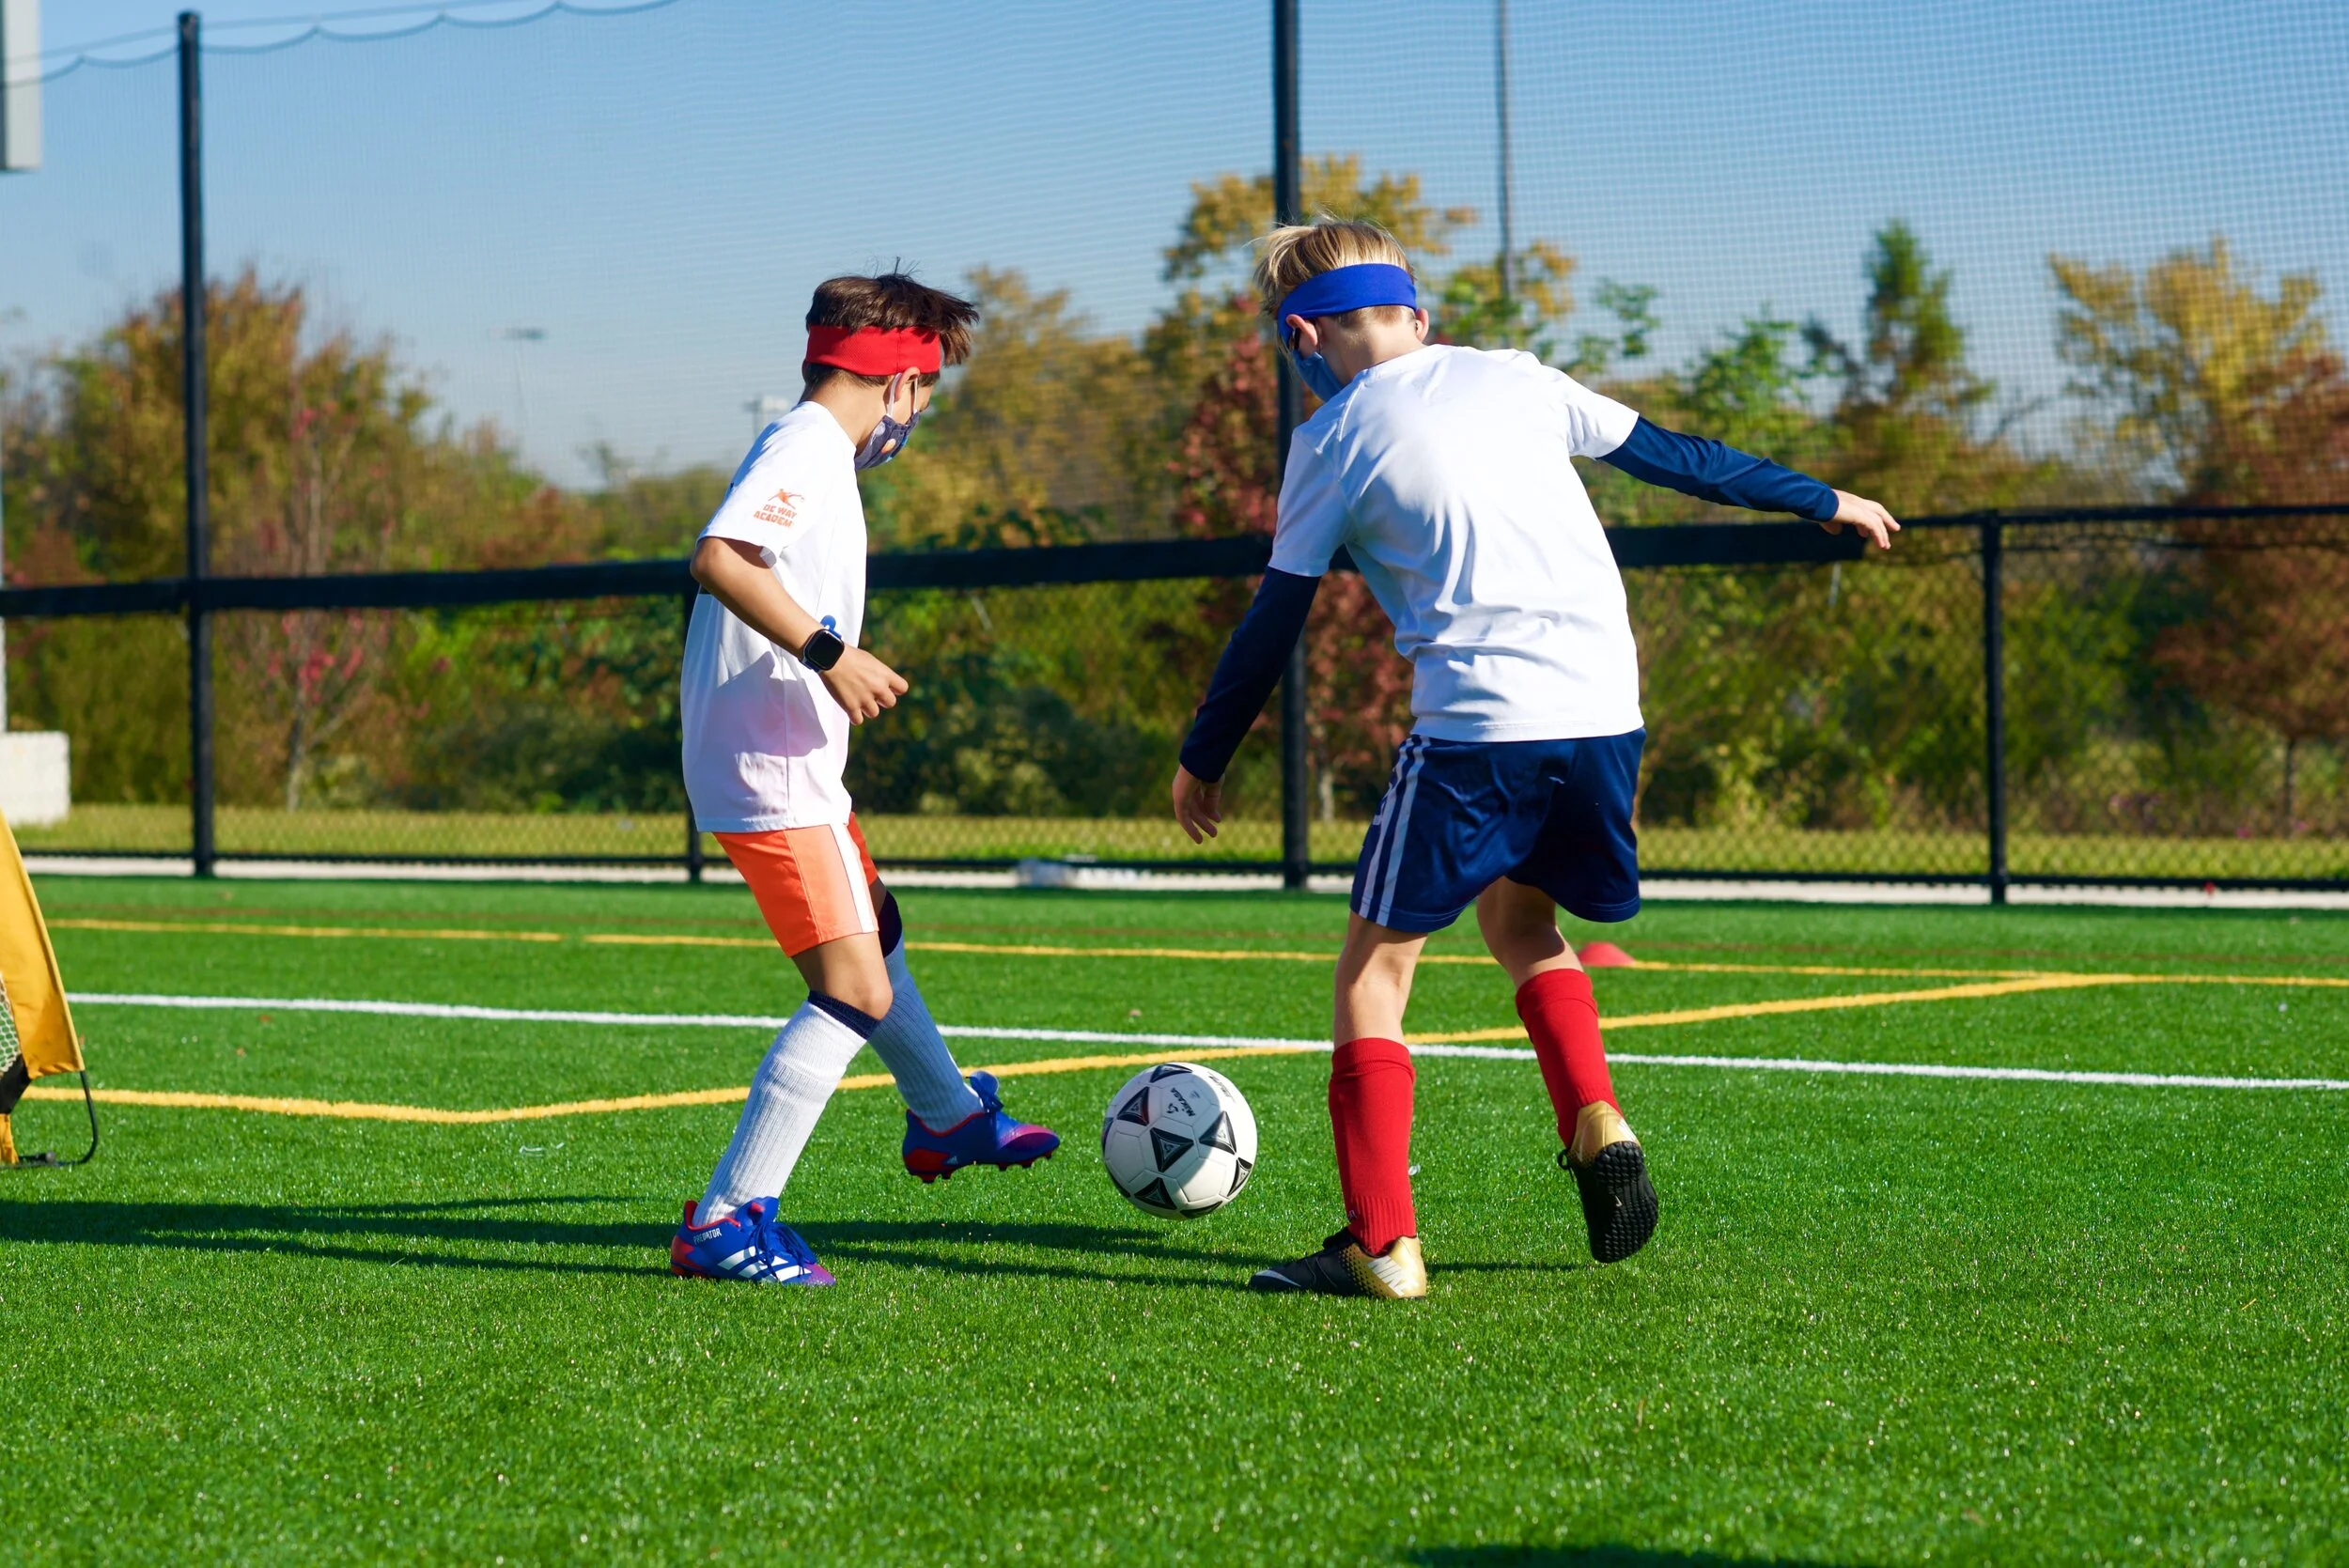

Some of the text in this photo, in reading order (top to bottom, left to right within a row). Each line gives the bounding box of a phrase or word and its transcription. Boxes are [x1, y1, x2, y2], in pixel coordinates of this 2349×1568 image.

[778, 506, 798, 520] WAY
[693, 1227, 723, 1245] PREDATOR
[1367, 1255, 1418, 1296] NIKE
